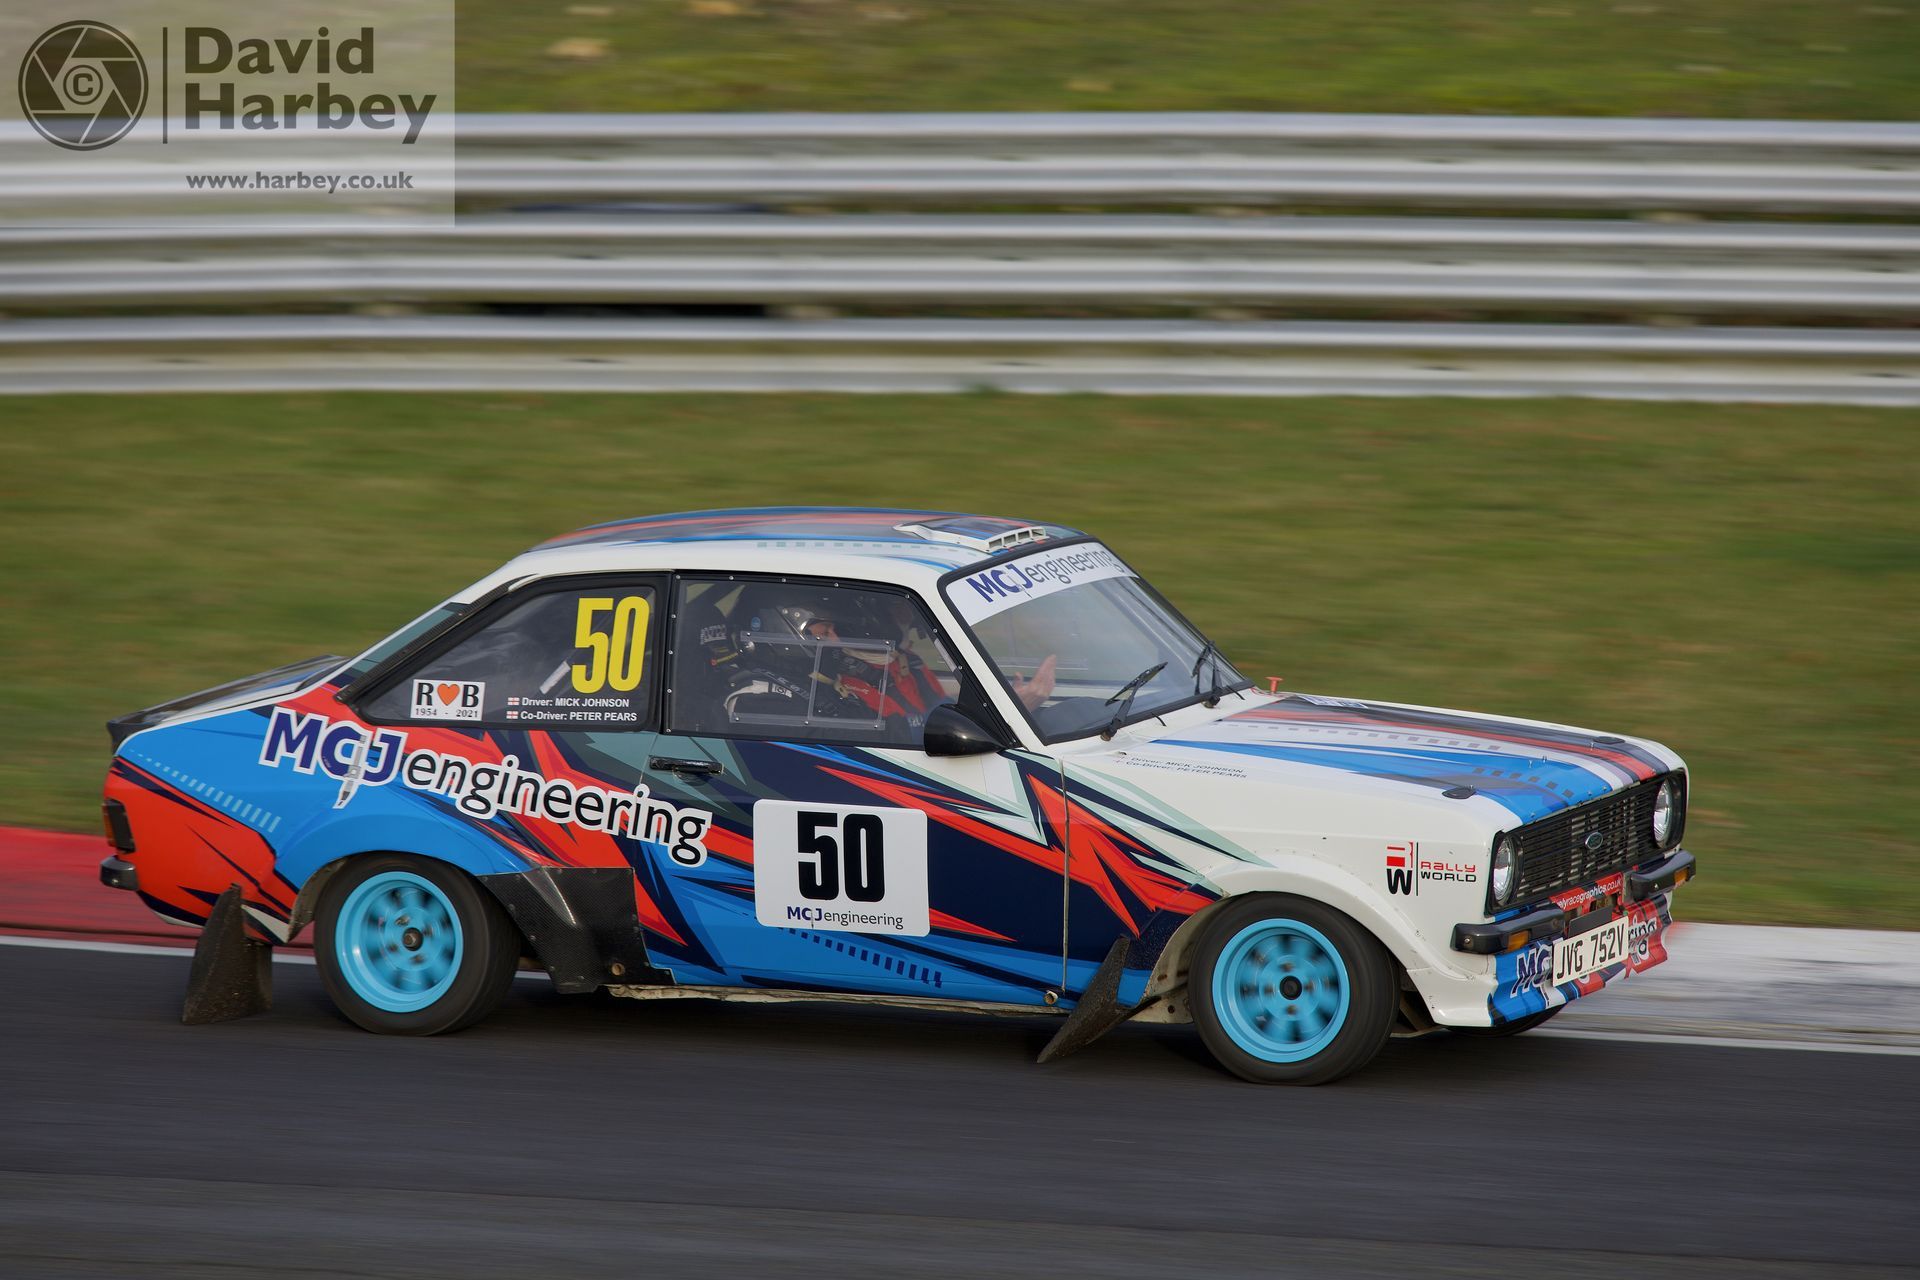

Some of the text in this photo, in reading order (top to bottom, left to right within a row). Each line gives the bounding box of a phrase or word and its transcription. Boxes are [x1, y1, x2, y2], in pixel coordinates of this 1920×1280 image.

[571, 595, 650, 694] 50
[416, 682, 480, 708] R B
[522, 697, 630, 708] Driver: MICK JOHNSON
[415, 708, 437, 716] 1954
[456, 709, 478, 718] 2021
[520, 711, 637, 721] Co-Driver: PETER PEARS
[797, 810, 885, 903] 50
[1420, 871, 1477, 882] WORLD
[1556, 923, 1625, 980] JVG 752V
